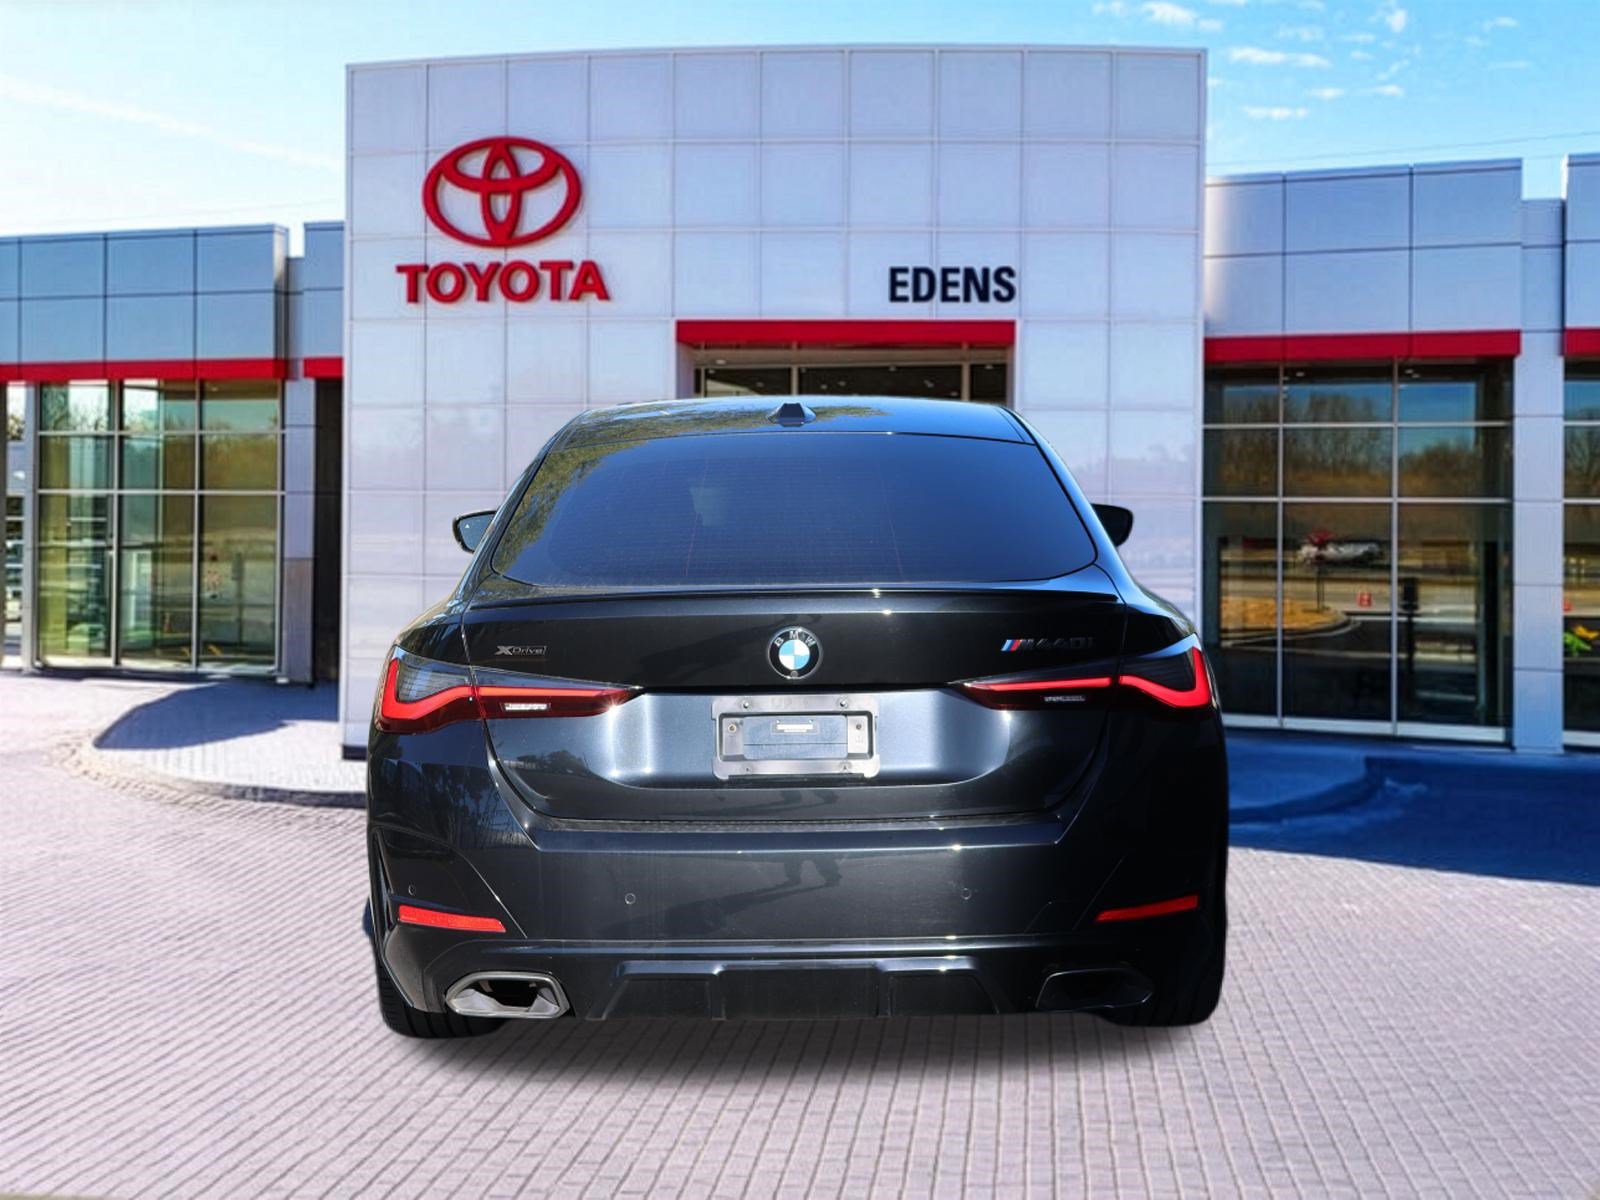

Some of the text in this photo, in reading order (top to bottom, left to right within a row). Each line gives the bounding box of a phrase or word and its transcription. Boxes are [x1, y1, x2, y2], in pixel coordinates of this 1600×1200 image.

[396, 260, 611, 303] TOYOTA
[889, 266, 1016, 303] EDENS
[771, 629, 817, 648] BMW
